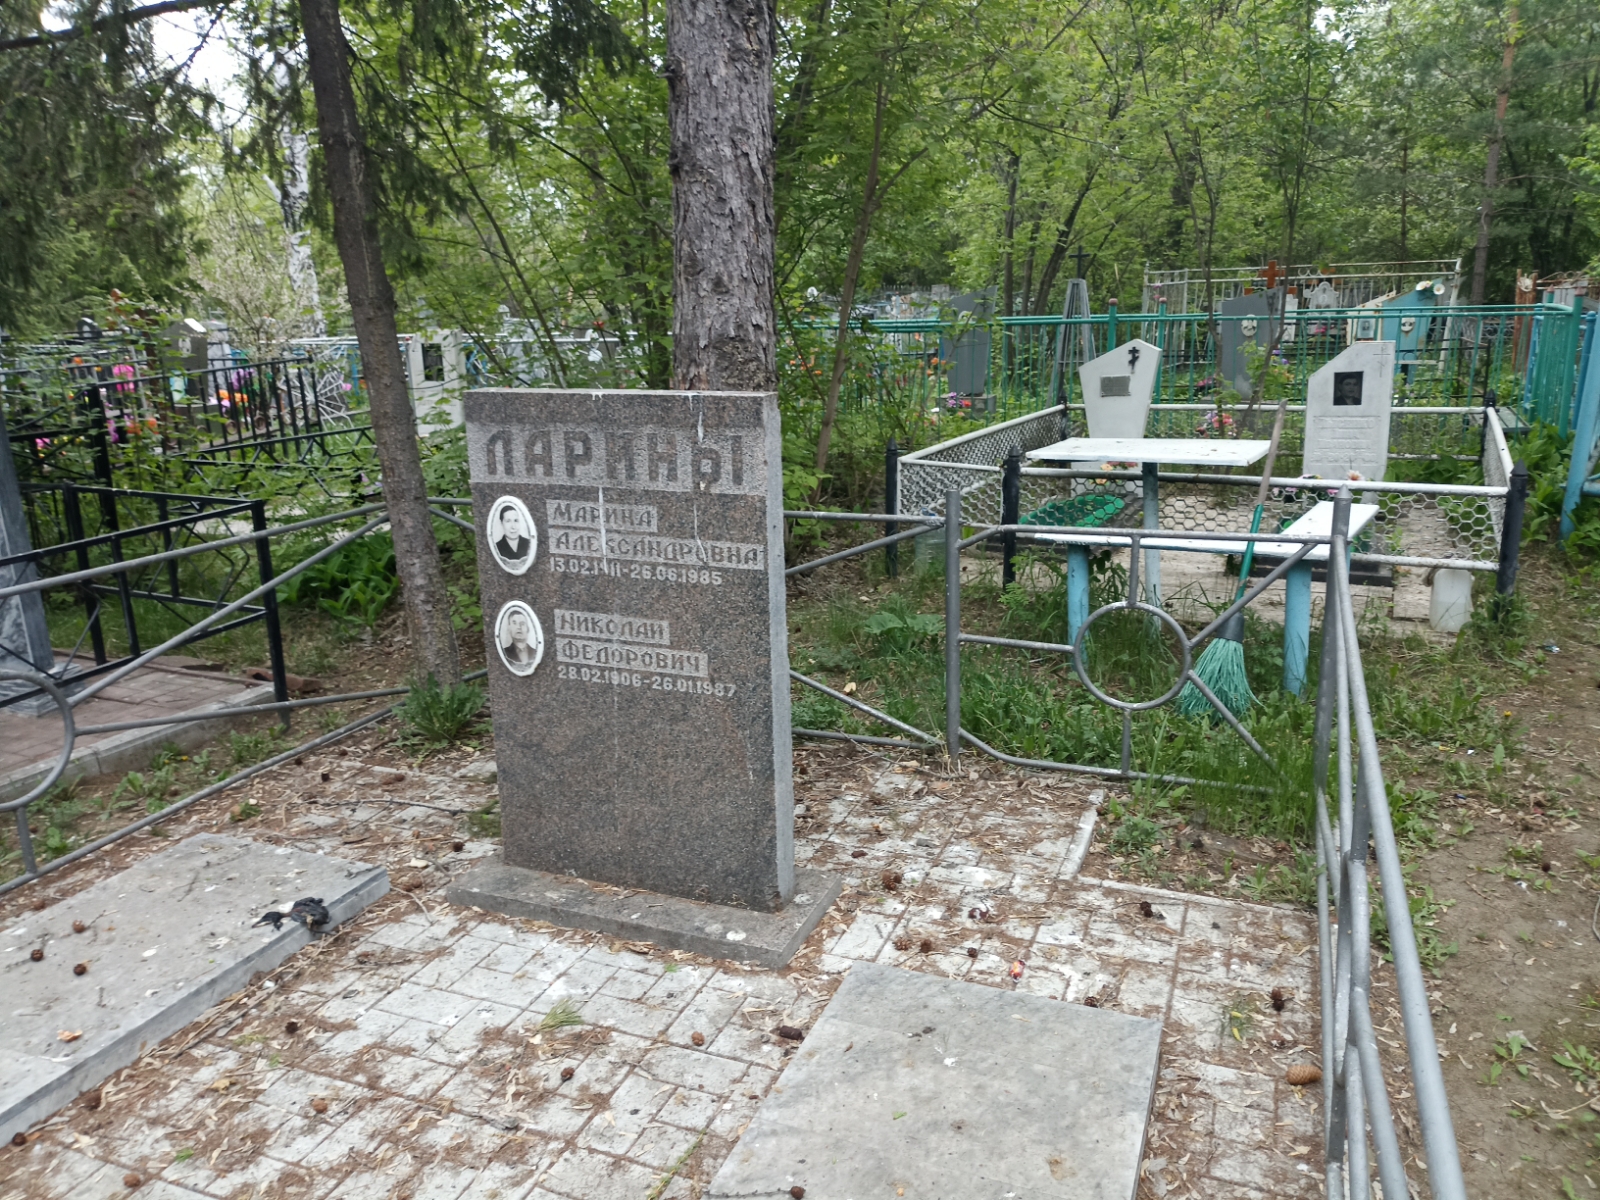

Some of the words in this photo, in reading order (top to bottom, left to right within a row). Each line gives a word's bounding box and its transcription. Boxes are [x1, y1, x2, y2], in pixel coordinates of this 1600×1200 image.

[486, 429, 744, 487] ЛАРИНЫ
[554, 502, 652, 526] МАРИНА
[555, 531, 758, 565] АЛЕКСАНДРОВНА
[561, 640, 700, 671] ФЕДОРОВИЧ
